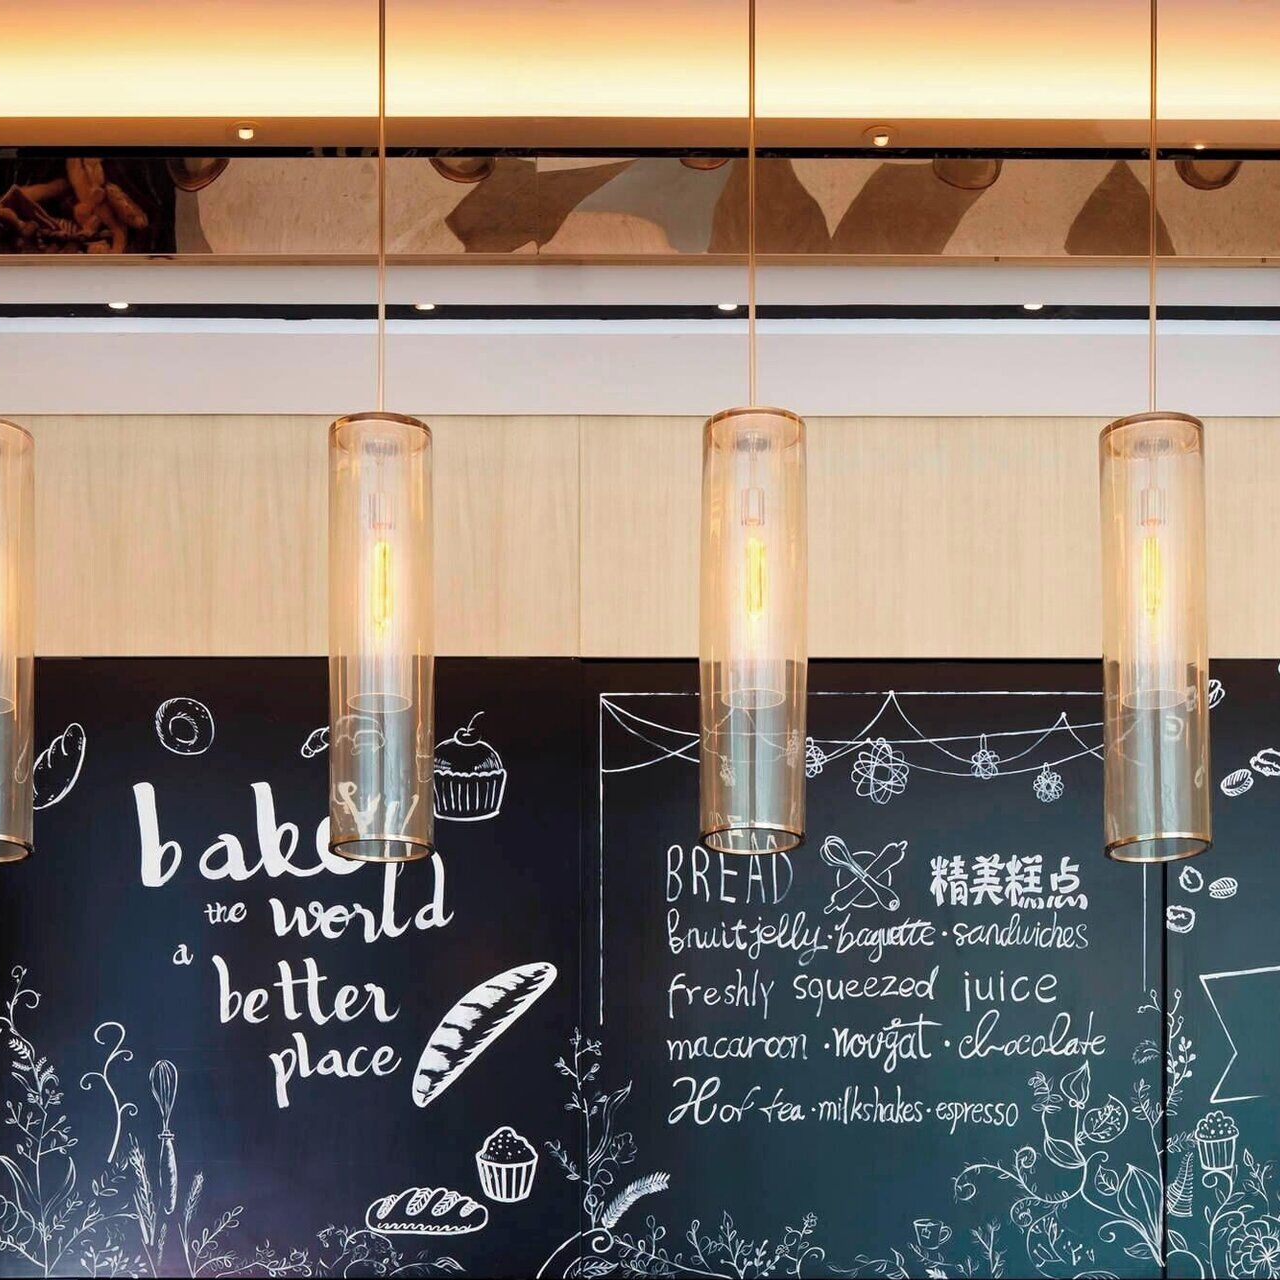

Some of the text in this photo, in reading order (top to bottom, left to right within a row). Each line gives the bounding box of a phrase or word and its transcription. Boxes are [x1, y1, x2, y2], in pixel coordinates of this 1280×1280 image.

[204, 853, 455, 943] the world
[666, 843, 794, 905] BREAD
[930, 853, 1089, 910] 精美糕点
[173, 944, 193, 965] a
[952, 912, 1089, 950] sandwiches
[212, 955, 399, 1025] better
[668, 965, 1058, 1020] freshly squeezed juice
[667, 1034, 808, 1060] macaroon
[958, 1009, 1106, 1059] chocolate
[269, 1032, 401, 1108] place
[759, 1088, 806, 1123] tea
[819, 1085, 924, 1125] milkshakes
[935, 1101, 1019, 1135] espresso
